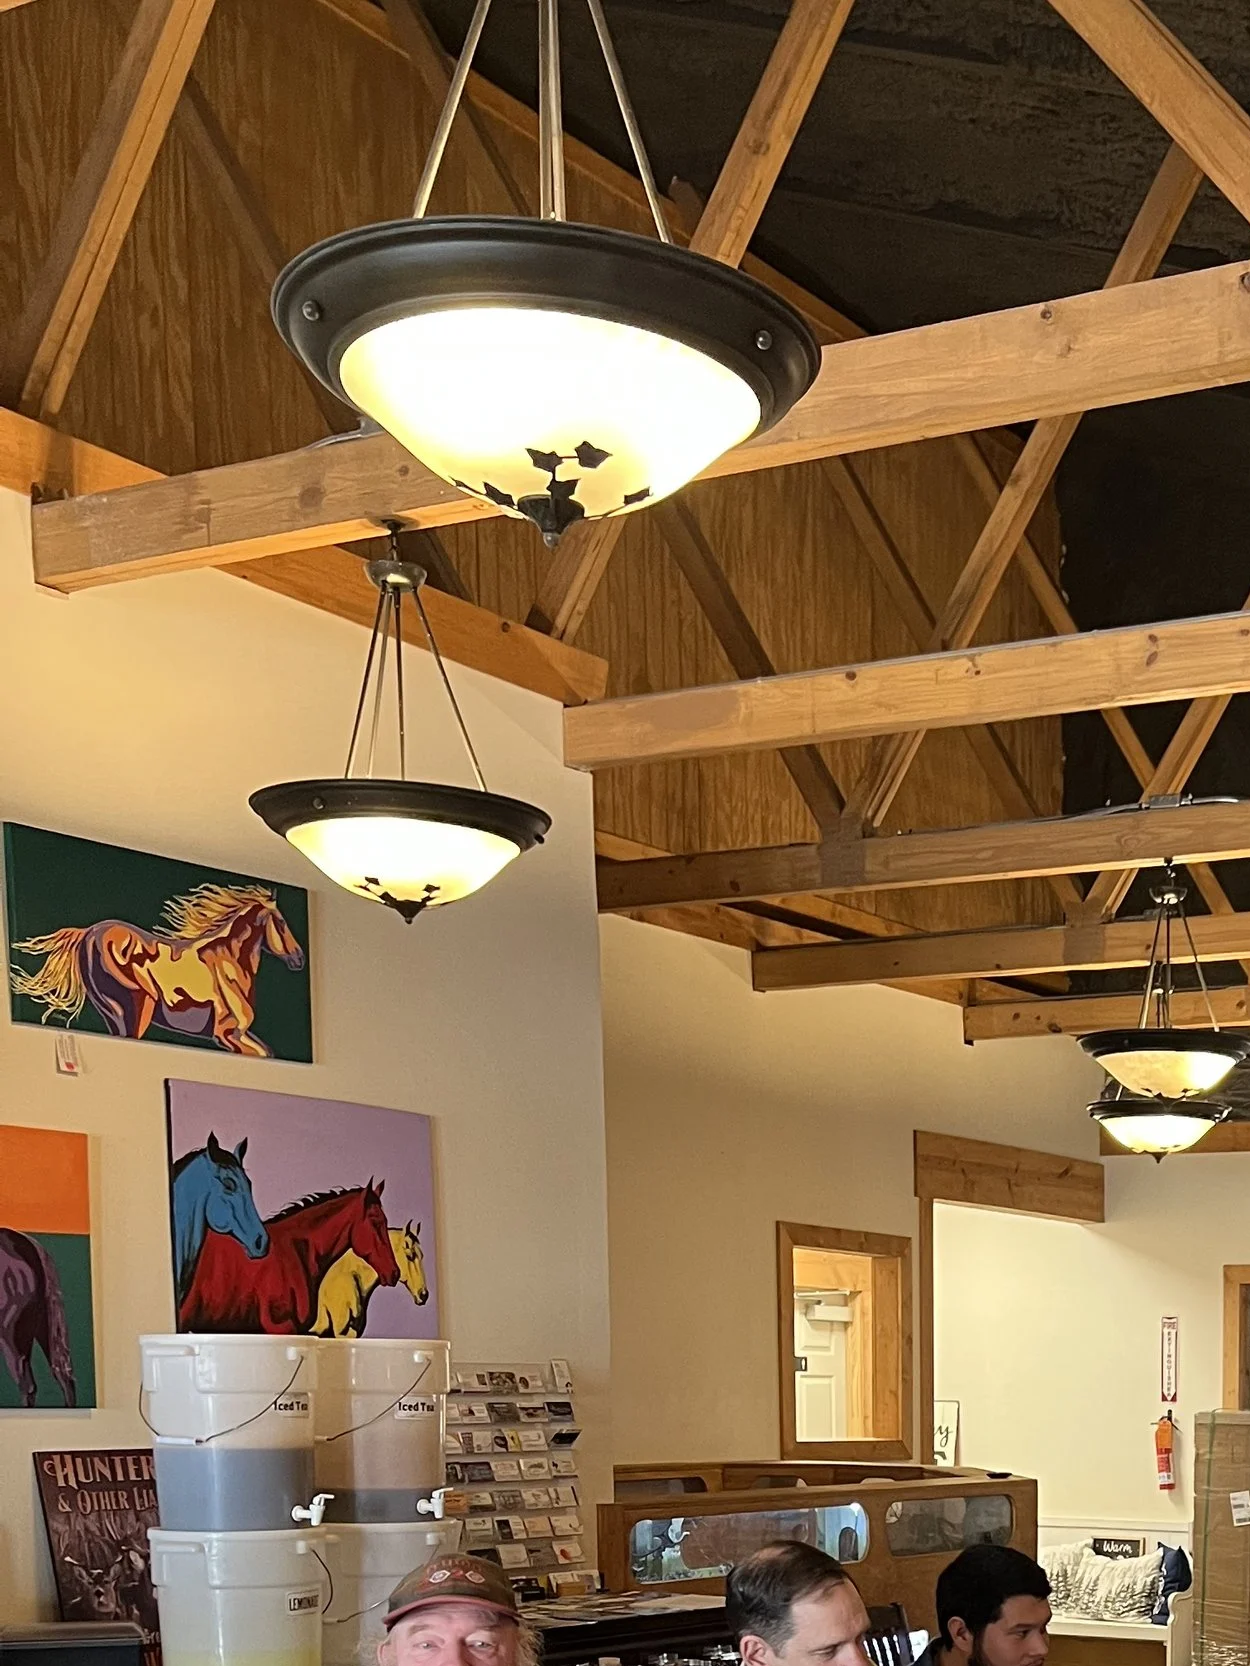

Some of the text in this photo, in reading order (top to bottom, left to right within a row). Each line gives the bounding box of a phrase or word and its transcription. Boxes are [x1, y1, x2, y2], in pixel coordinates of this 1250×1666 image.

[274, 1400, 294, 1411] Iced
[398, 1402, 419, 1412] Iced
[58, 1492, 72, 1513] &
[1103, 1540, 1133, 1554] Warm
[289, 1594, 319, 1611] LEMON
